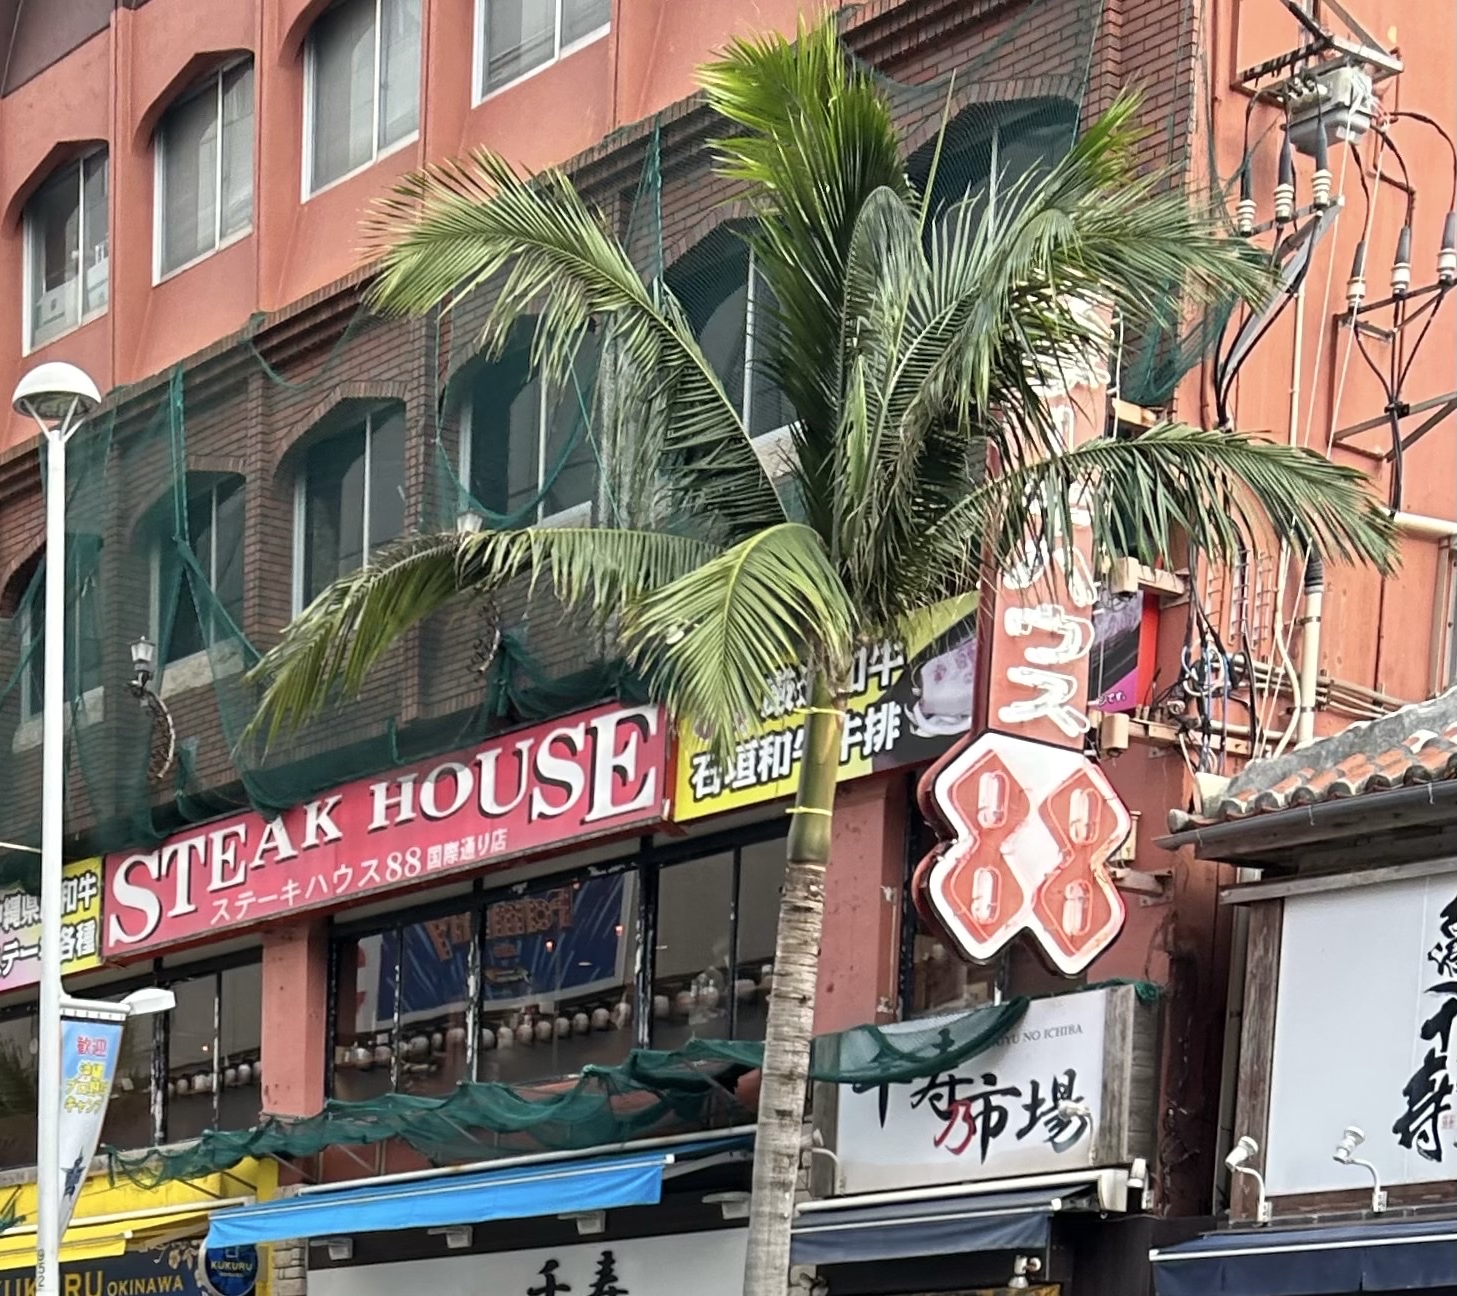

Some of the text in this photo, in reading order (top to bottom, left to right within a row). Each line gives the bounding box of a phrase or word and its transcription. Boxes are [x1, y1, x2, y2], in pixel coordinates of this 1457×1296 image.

[109, 795, 343, 948] STEAK
[367, 704, 660, 832] HOUSE
[426, 828, 508, 871] 国際通り店
[945, 747, 1123, 957] 88
[1044, 1023, 1083, 1040] ICHIBA
[211, 1261, 253, 1271] KUKURU
